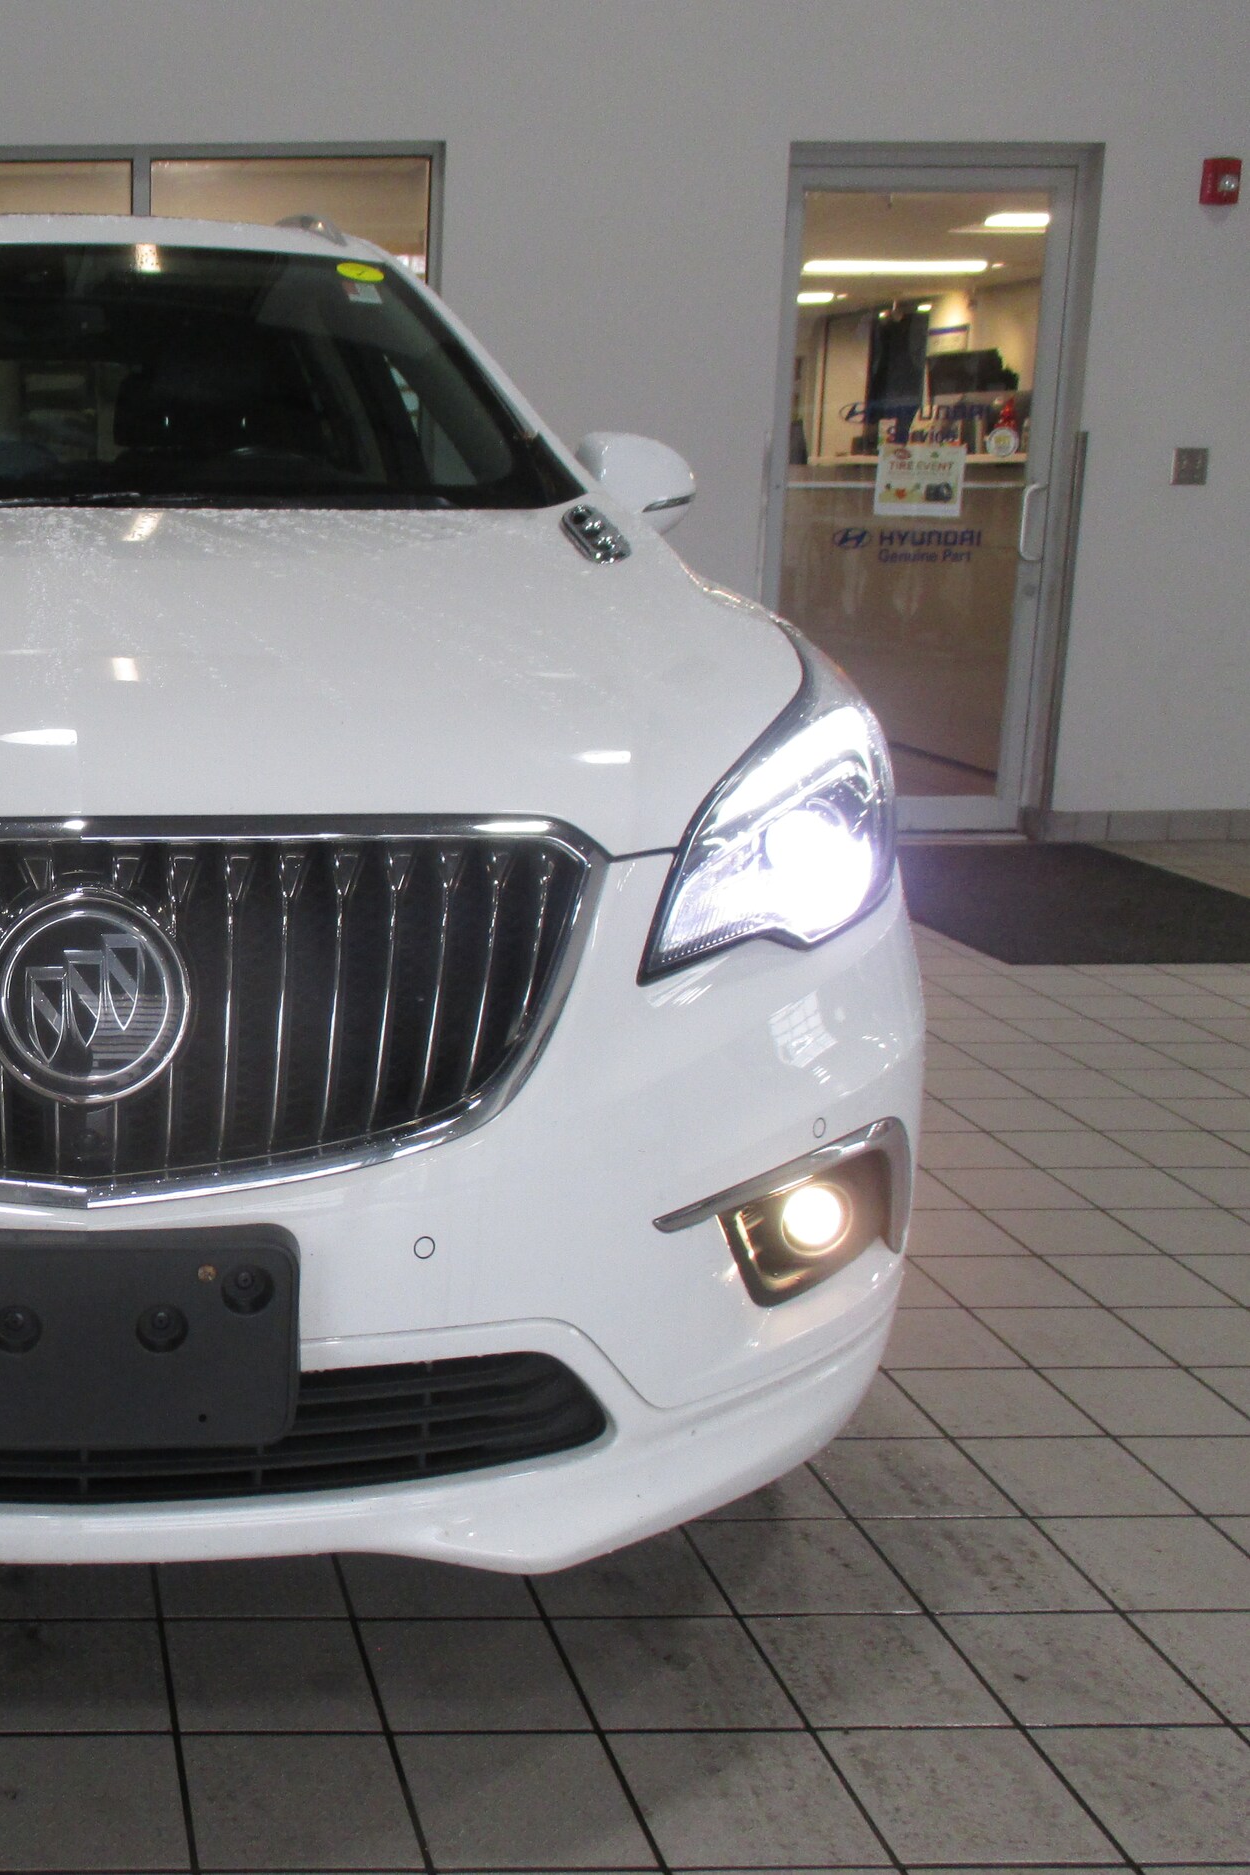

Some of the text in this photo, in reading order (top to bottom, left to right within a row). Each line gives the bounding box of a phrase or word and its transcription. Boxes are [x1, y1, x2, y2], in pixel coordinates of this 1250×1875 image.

[889, 460, 955, 470] TIRE EVENT
[879, 529, 982, 546] HYUNDAI
[878, 549, 971, 562] Genuine Part
